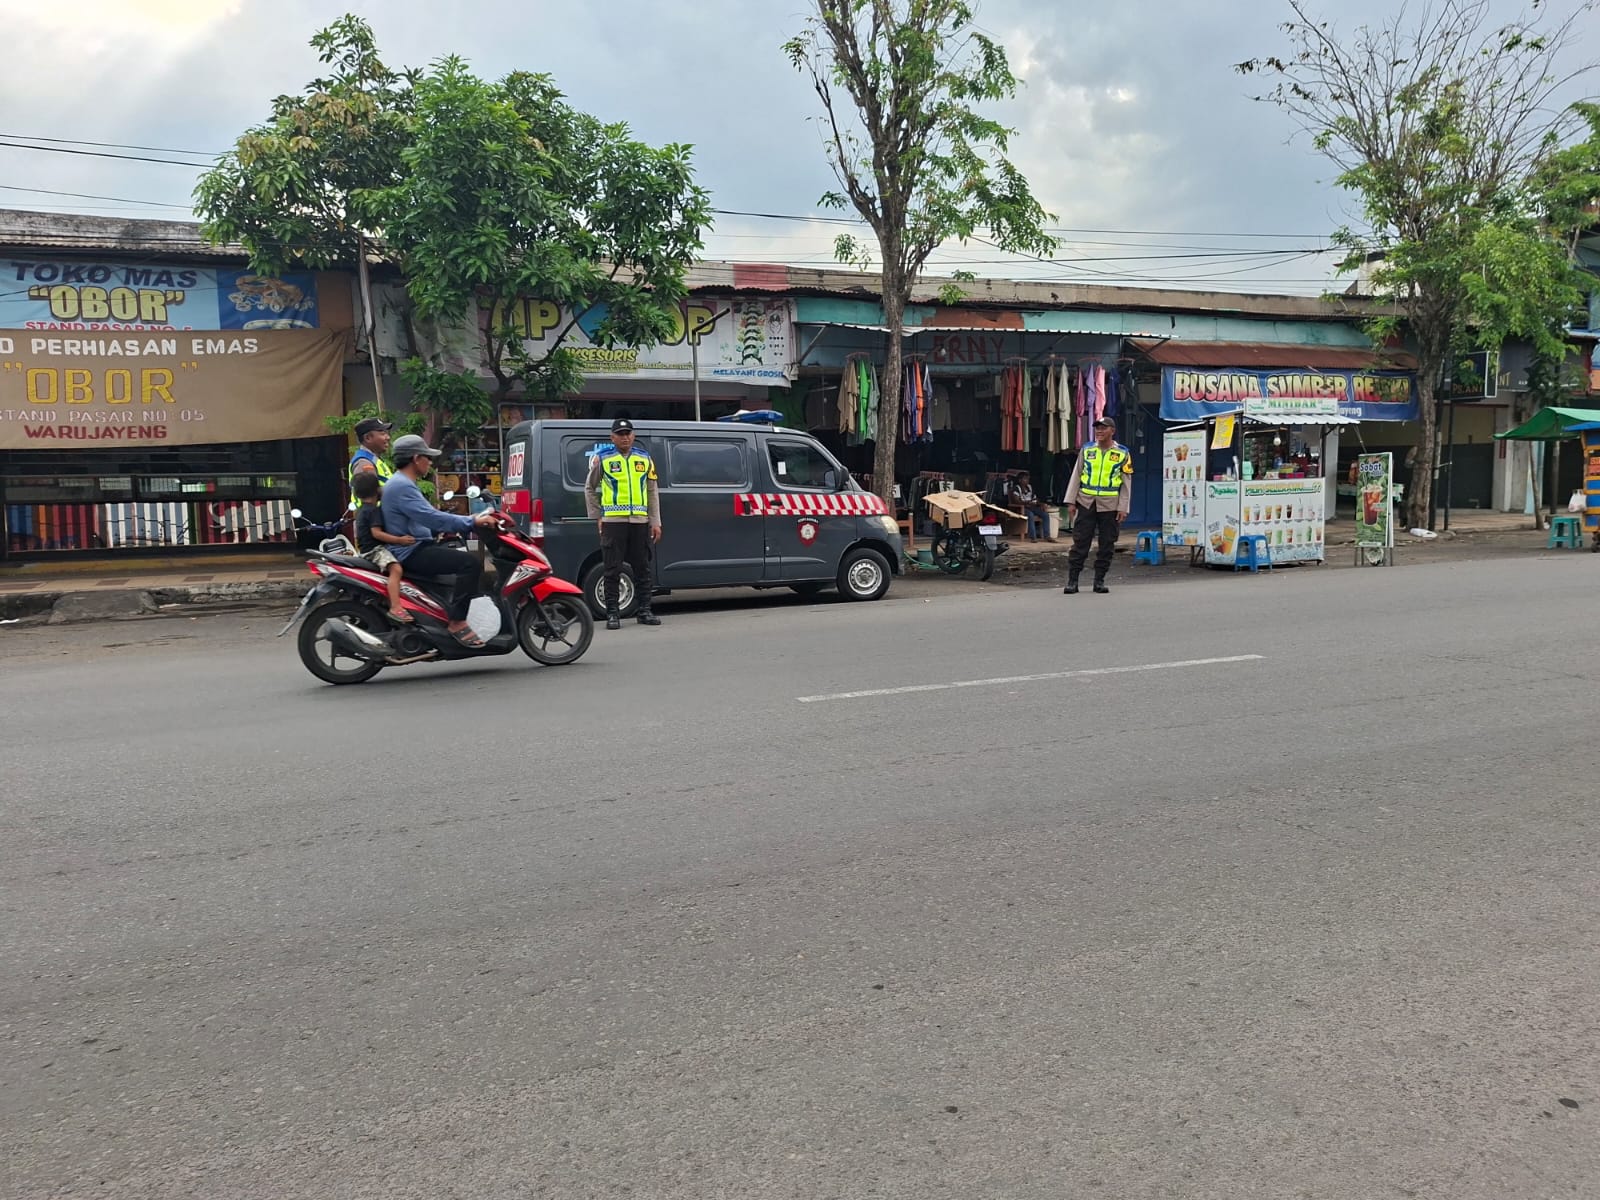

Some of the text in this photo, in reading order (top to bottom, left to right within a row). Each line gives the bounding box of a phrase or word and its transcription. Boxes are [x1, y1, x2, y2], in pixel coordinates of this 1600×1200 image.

[11, 262, 197, 288] TOKO MAS
[31, 338, 177, 356] PERHIASAN
[192, 338, 259, 355] EMAS
[933, 335, 1004, 362] ERNY
[713, 369, 755, 377] MELAYANI
[1174, 371, 1262, 401] BUSANA
[1266, 374, 1348, 401] SUMBER
[69, 410, 134, 423] PASAR
[24, 425, 168, 440] WARUJAYENG
